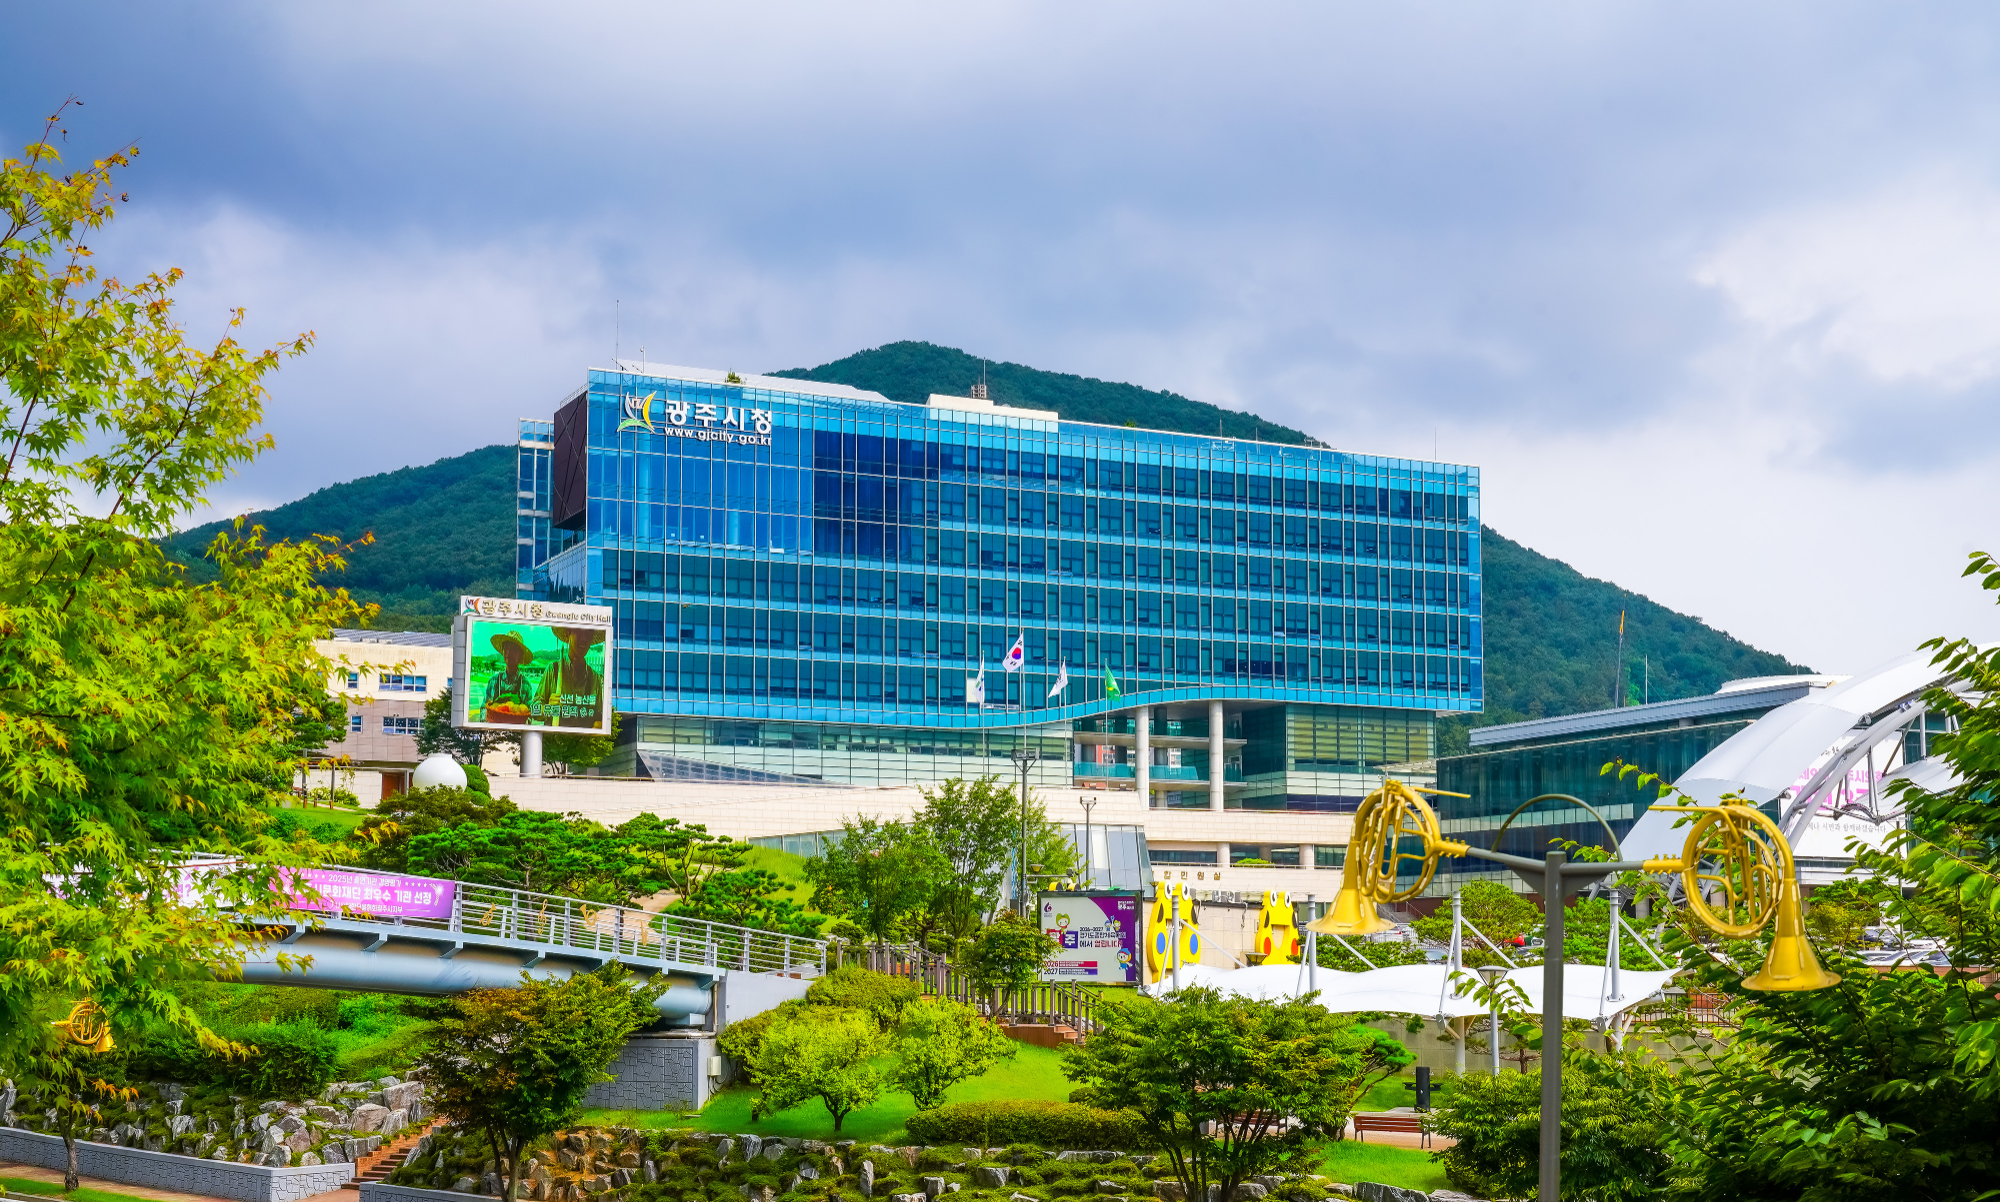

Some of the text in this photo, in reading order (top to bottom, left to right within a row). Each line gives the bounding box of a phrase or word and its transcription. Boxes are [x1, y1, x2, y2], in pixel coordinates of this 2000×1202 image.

[665, 400, 772, 434] 광주시청
[665, 427, 772, 446] www.gjcity.go.kr
[482, 600, 544, 618] 광주시청
[580, 611, 596, 623] City
[597, 613, 611, 623] Hall
[560, 694, 574, 704] 신선
[328, 873, 353, 884] 2025년
[1152, 870, 1221, 881] 합민원실
[363, 887, 391, 901] 최우수
[394, 889, 412, 903] 기관
[414, 891, 432, 905] 선정
[1079, 940, 1093, 948] 에서
[1043, 960, 1059, 968] 2026
